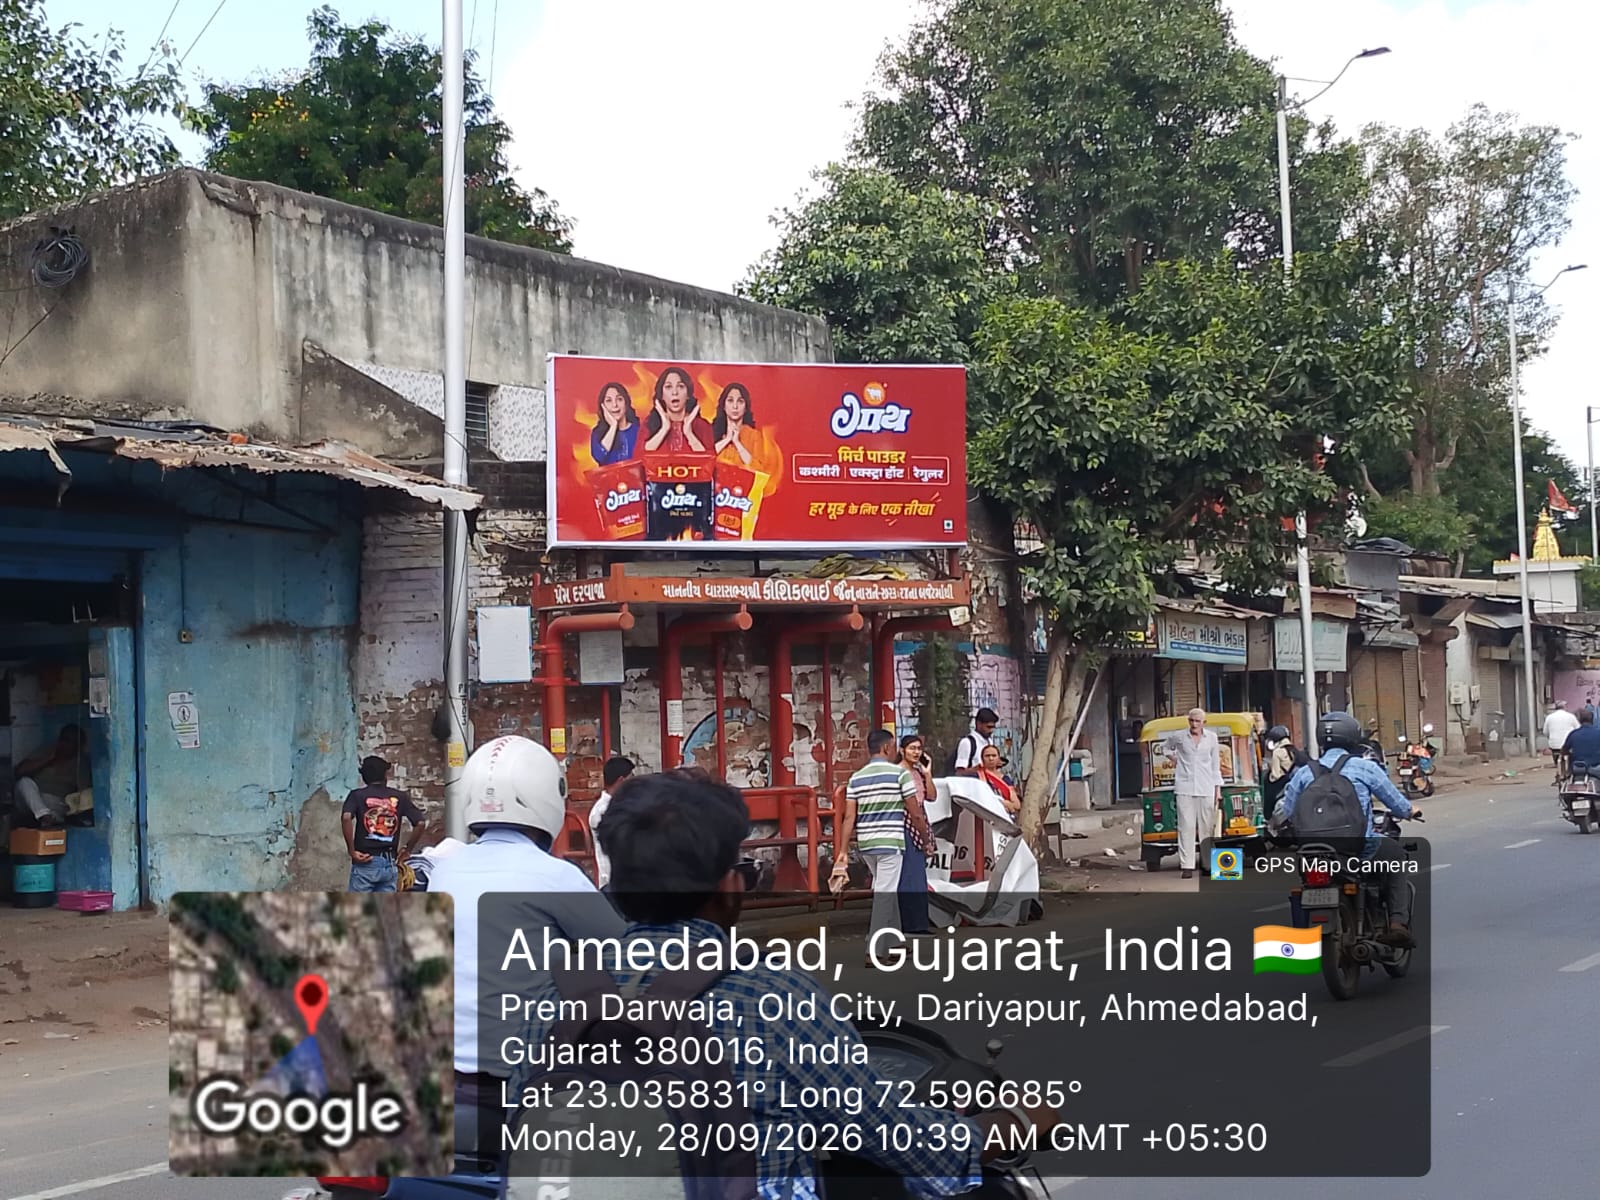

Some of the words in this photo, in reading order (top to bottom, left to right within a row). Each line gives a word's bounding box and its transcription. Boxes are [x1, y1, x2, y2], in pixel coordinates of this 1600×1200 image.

[838, 446, 864, 464] मिर्च
[866, 450, 907, 465] पाउडर
[657, 466, 702, 478] HOT
[809, 502, 824, 516] हर
[827, 502, 846, 520] मूड
[848, 503, 858, 516] के
[859, 503, 879, 516] लिए
[880, 502, 902, 516] एक
[903, 500, 936, 517] तीखा
[554, 583, 571, 605] પ્રેમ
